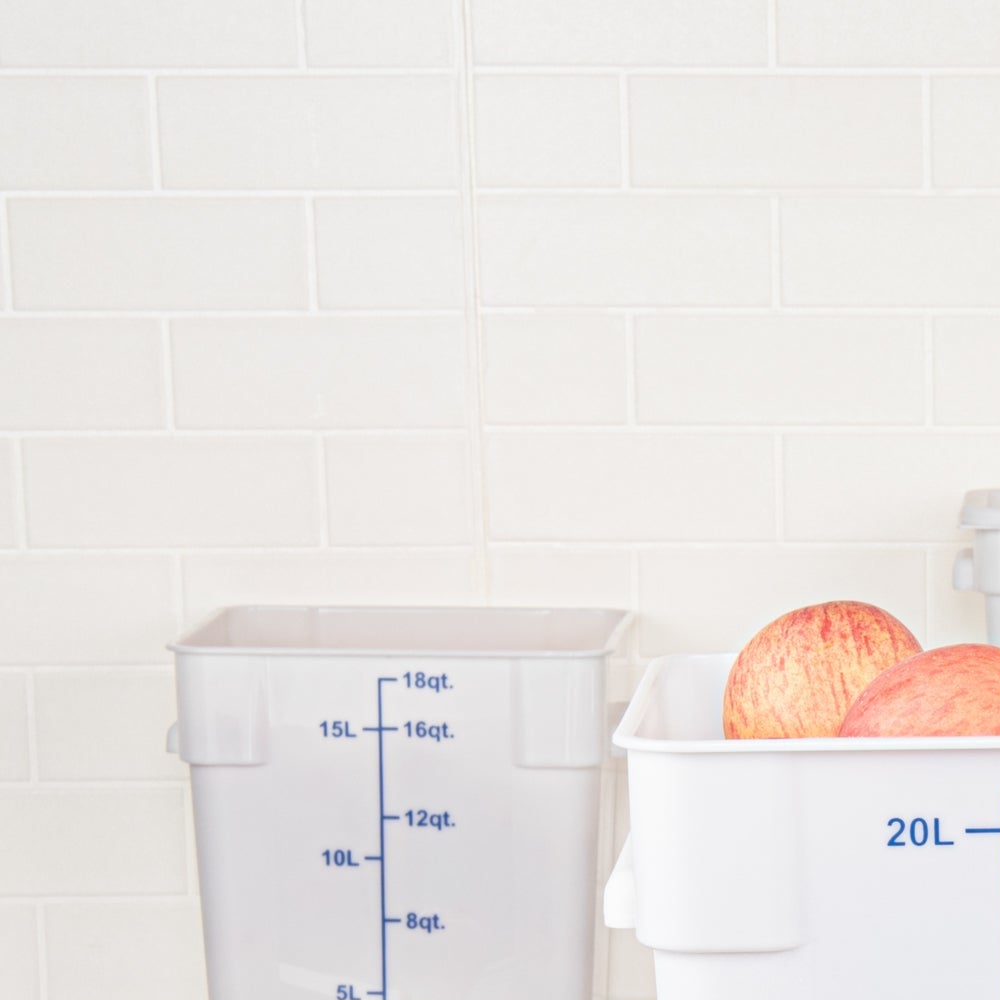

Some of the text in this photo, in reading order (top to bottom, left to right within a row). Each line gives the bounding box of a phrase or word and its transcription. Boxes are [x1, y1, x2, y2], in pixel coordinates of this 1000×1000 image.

[403, 671, 454, 693] 18qt.
[320, 720, 357, 739] 15L
[404, 721, 455, 743] 16qt.
[406, 809, 456, 831] 12qt.
[887, 817, 955, 847] 20L
[322, 848, 360, 867] 10L
[405, 912, 446, 933] 8qt.
